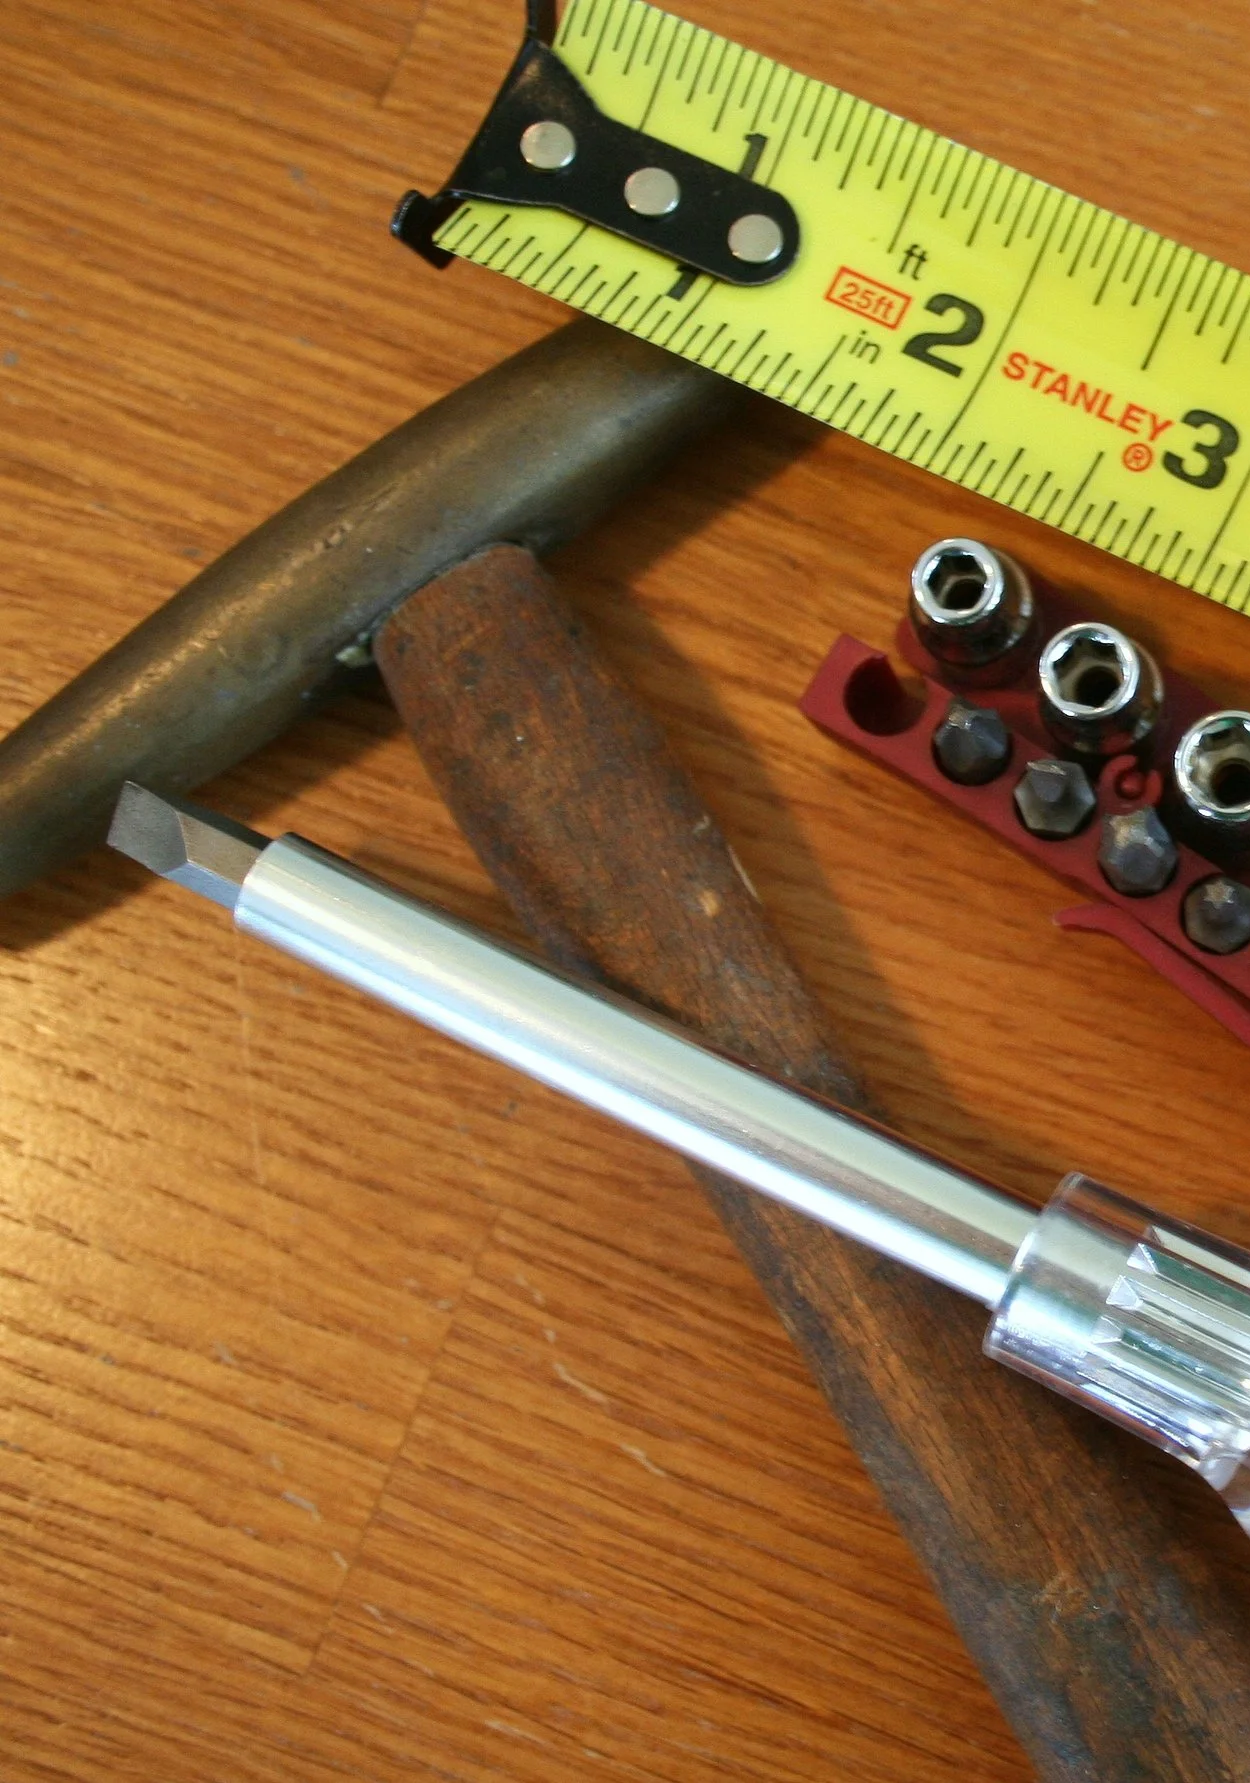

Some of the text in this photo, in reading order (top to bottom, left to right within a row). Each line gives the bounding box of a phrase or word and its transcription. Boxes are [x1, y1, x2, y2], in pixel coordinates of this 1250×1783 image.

[898, 244, 928, 281] ft
[839, 282, 896, 321] 25ft
[849, 329, 882, 365] in
[902, 293, 985, 378] 2
[1001, 351, 1174, 443] STANLEY
[1161, 409, 1241, 490] 3
